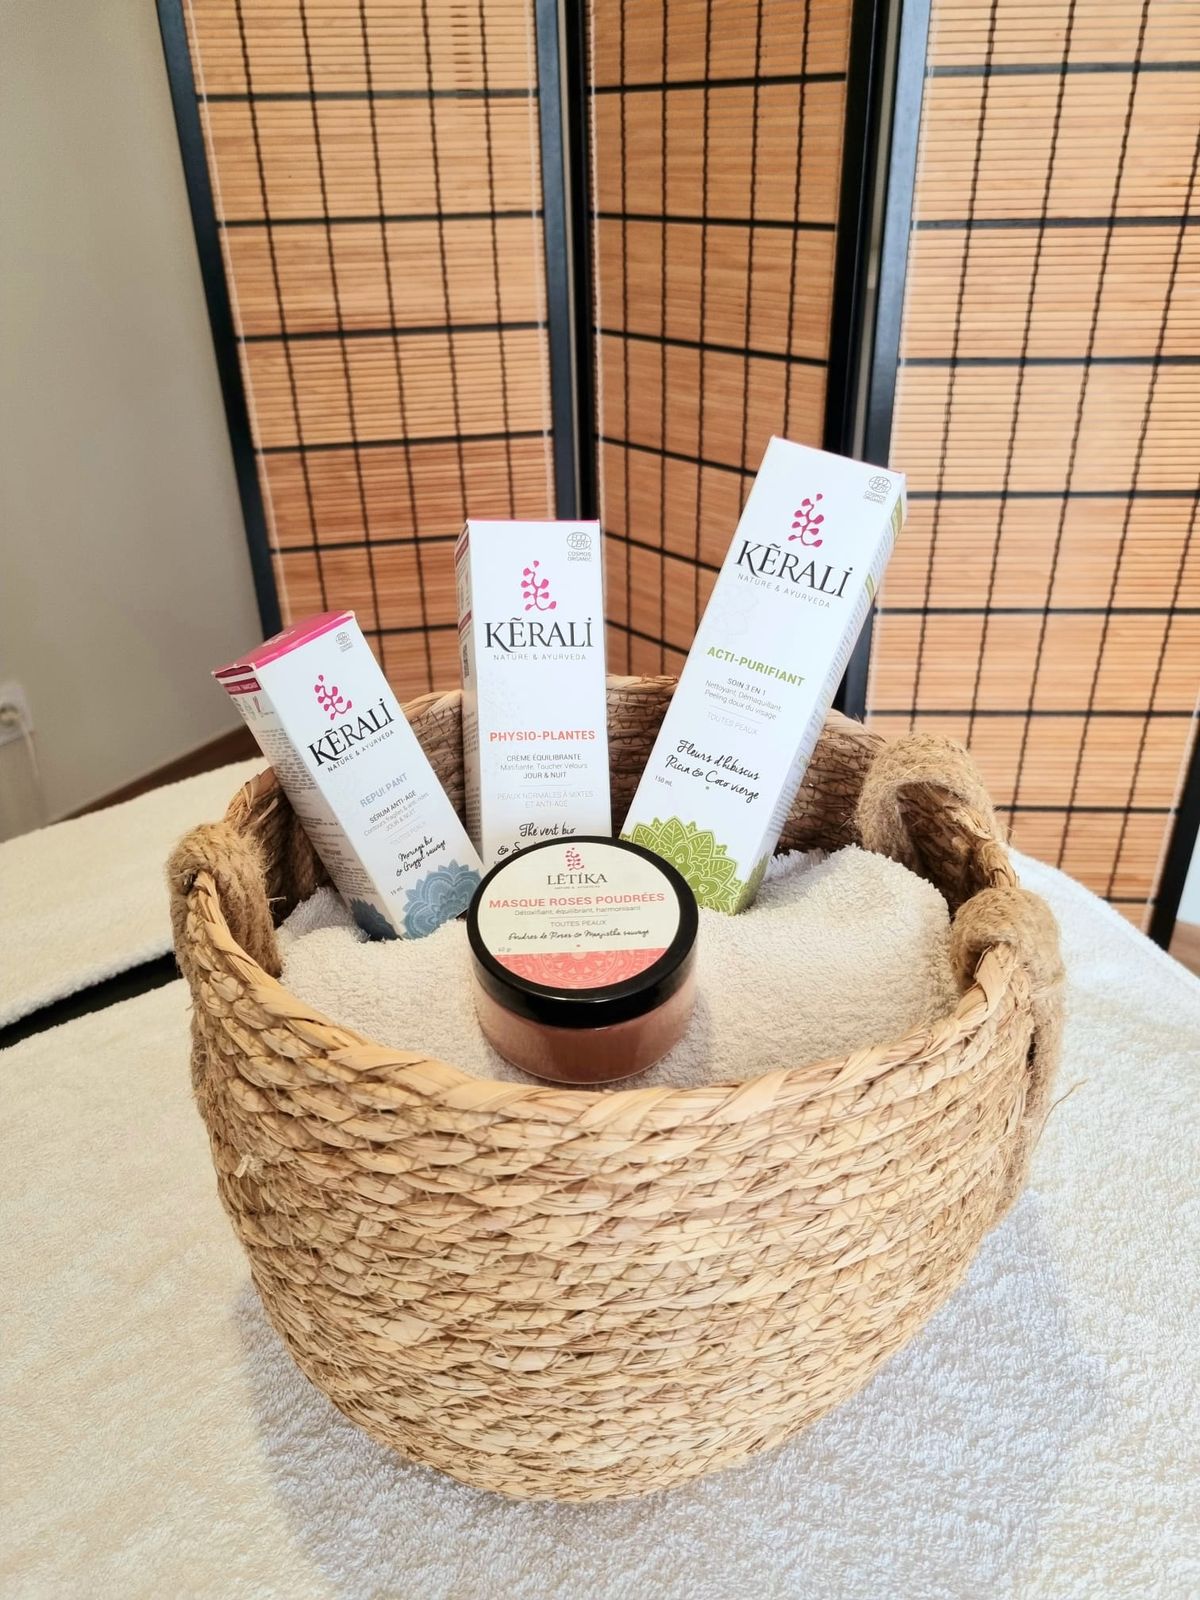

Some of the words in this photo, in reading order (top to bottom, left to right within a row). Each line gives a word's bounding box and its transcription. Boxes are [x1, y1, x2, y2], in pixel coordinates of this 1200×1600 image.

[737, 573, 772, 590] NATURE
[775, 584, 781, 593] &
[784, 588, 831, 609] AYURVEDA
[541, 653, 587, 661] AYURVEDA
[707, 646, 806, 687] ACTI-PURIFIANT
[727, 677, 745, 690] SOIN
[745, 683, 751, 691] 3
[751, 685, 762, 694] EN
[704, 688, 728, 704] Peeling
[728, 697, 745, 710] doux
[745, 702, 755, 712] du
[755, 707, 777, 721] visage
[706, 711, 734, 727] TOUTES
[734, 721, 759, 736] PEAUX
[489, 730, 596, 742] PHYSIO-PLANTES
[327, 754, 354, 773] NATURE
[362, 729, 395, 752] AYURVEDA
[506, 752, 530, 762] CRÈME
[532, 752, 582, 762] ÉQUILIBRANTE
[676, 739, 713, 764] Fleurs
[537, 762, 563, 770] Toucher
[550, 771, 567, 779] NUIT
[664, 754, 691, 775] Ricin
[691, 767, 704, 778] &
[705, 770, 730, 788] Coco
[730, 783, 760, 804] vierge
[540, 823, 559, 836] vert
[562, 820, 577, 835] bio
[489, 898, 546, 909] MASQUE
[549, 896, 592, 907] ROSES
[595, 892, 665, 904] POUDRÉES
[550, 920, 580, 928] TOUTES
[581, 919, 607, 927] PEAUX
[539, 931, 547, 939] de
[549, 931, 572, 940] Roses
